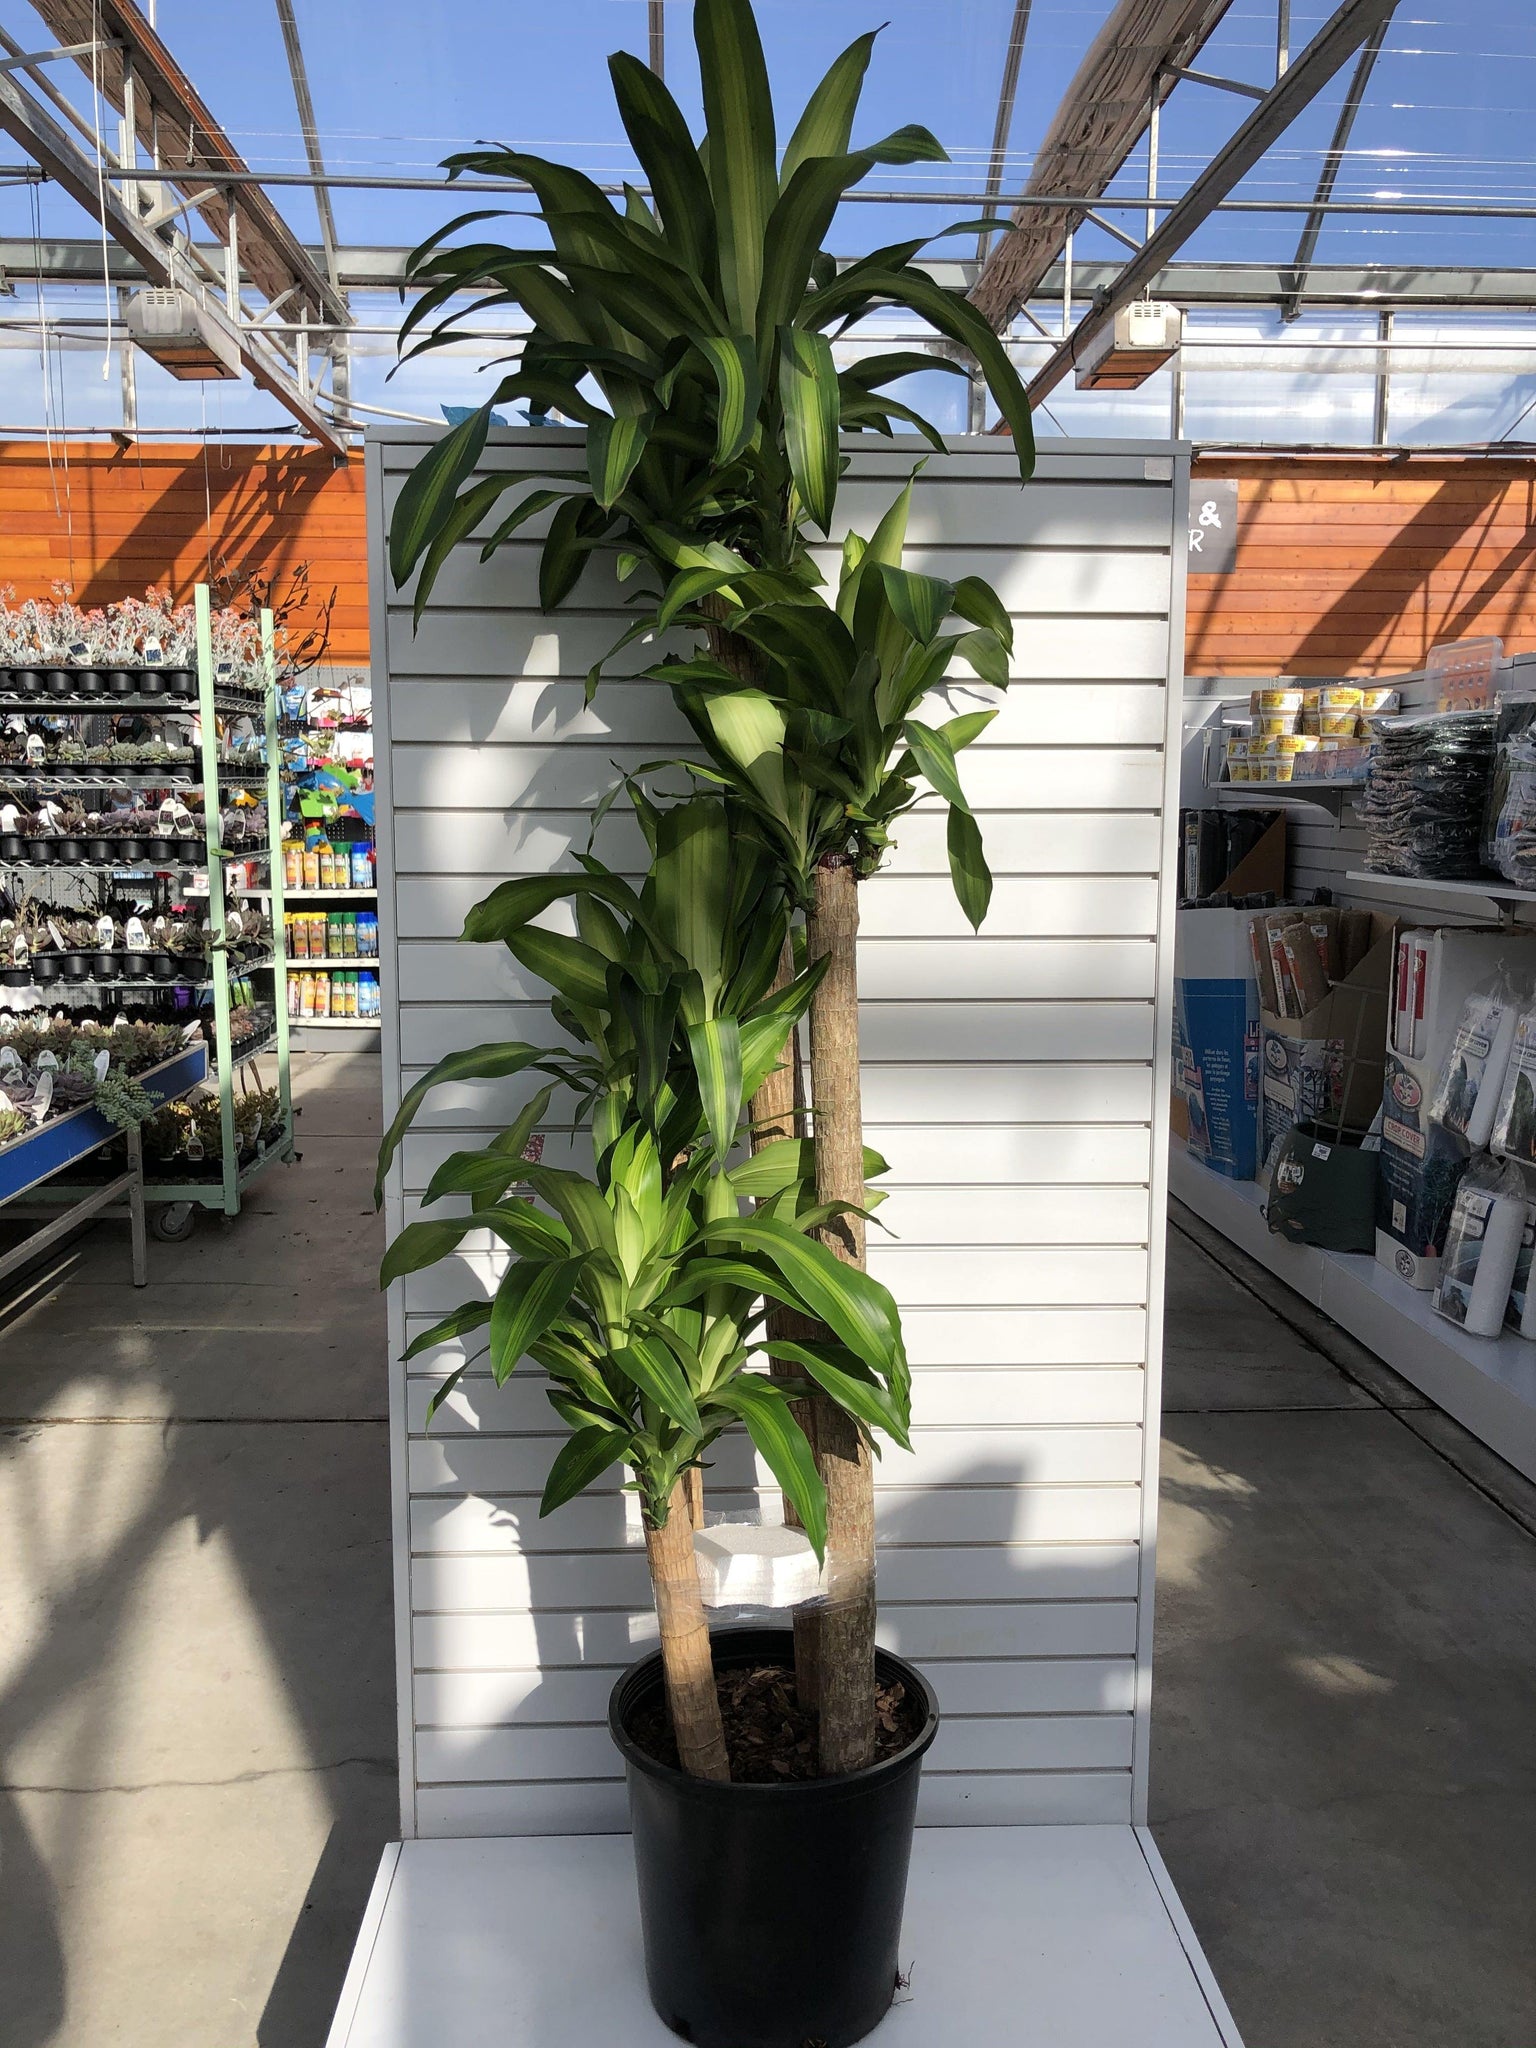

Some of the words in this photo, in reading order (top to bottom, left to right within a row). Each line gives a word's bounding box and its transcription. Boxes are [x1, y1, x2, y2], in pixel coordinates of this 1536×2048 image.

[1199, 501, 1222, 529] &
[1388, 1121, 1401, 1132] CROP
[1402, 1129, 1420, 1144] COVER
